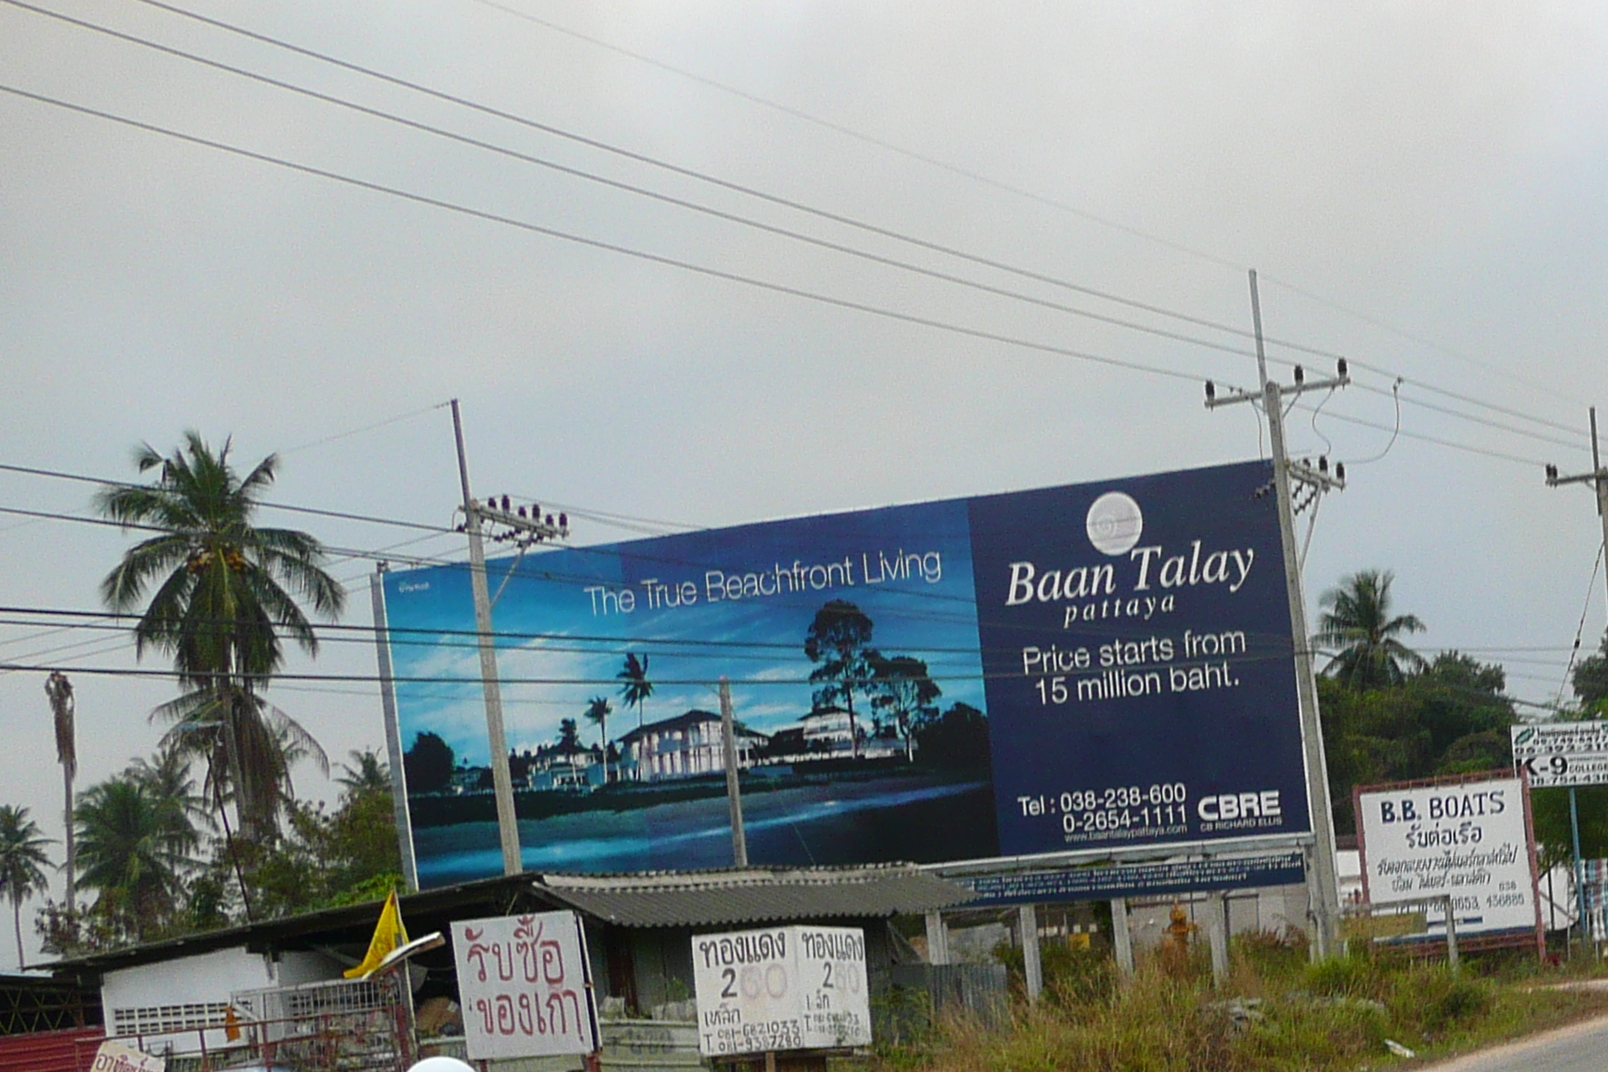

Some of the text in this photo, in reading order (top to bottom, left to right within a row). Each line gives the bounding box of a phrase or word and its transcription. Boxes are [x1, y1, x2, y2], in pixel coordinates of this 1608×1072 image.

[584, 548, 943, 616] The True Beachfront Living
[1005, 540, 1254, 606] Baan Talay
[1063, 594, 1175, 629] pattaya
[1023, 630, 1247, 675] Price starts from
[1035, 660, 1240, 705] 15 million baht.
[1018, 796, 1045, 817] Tel
[1060, 783, 1187, 814] 038-238-600
[1197, 790, 1282, 822] CBRE
[1380, 791, 1505, 824] B.B. BOATS
[1063, 806, 1187, 833] 0-2654-1111
[1200, 815, 1282, 833] CB RICHARD ELLIS
[1405, 820, 1484, 849] รับต่อเรือ
[465, 915, 565, 984] รับซื้อ
[699, 931, 787, 968] ทองแดง
[802, 932, 865, 962] ทองแดง
[704, 1000, 742, 1028] เหล็ก
